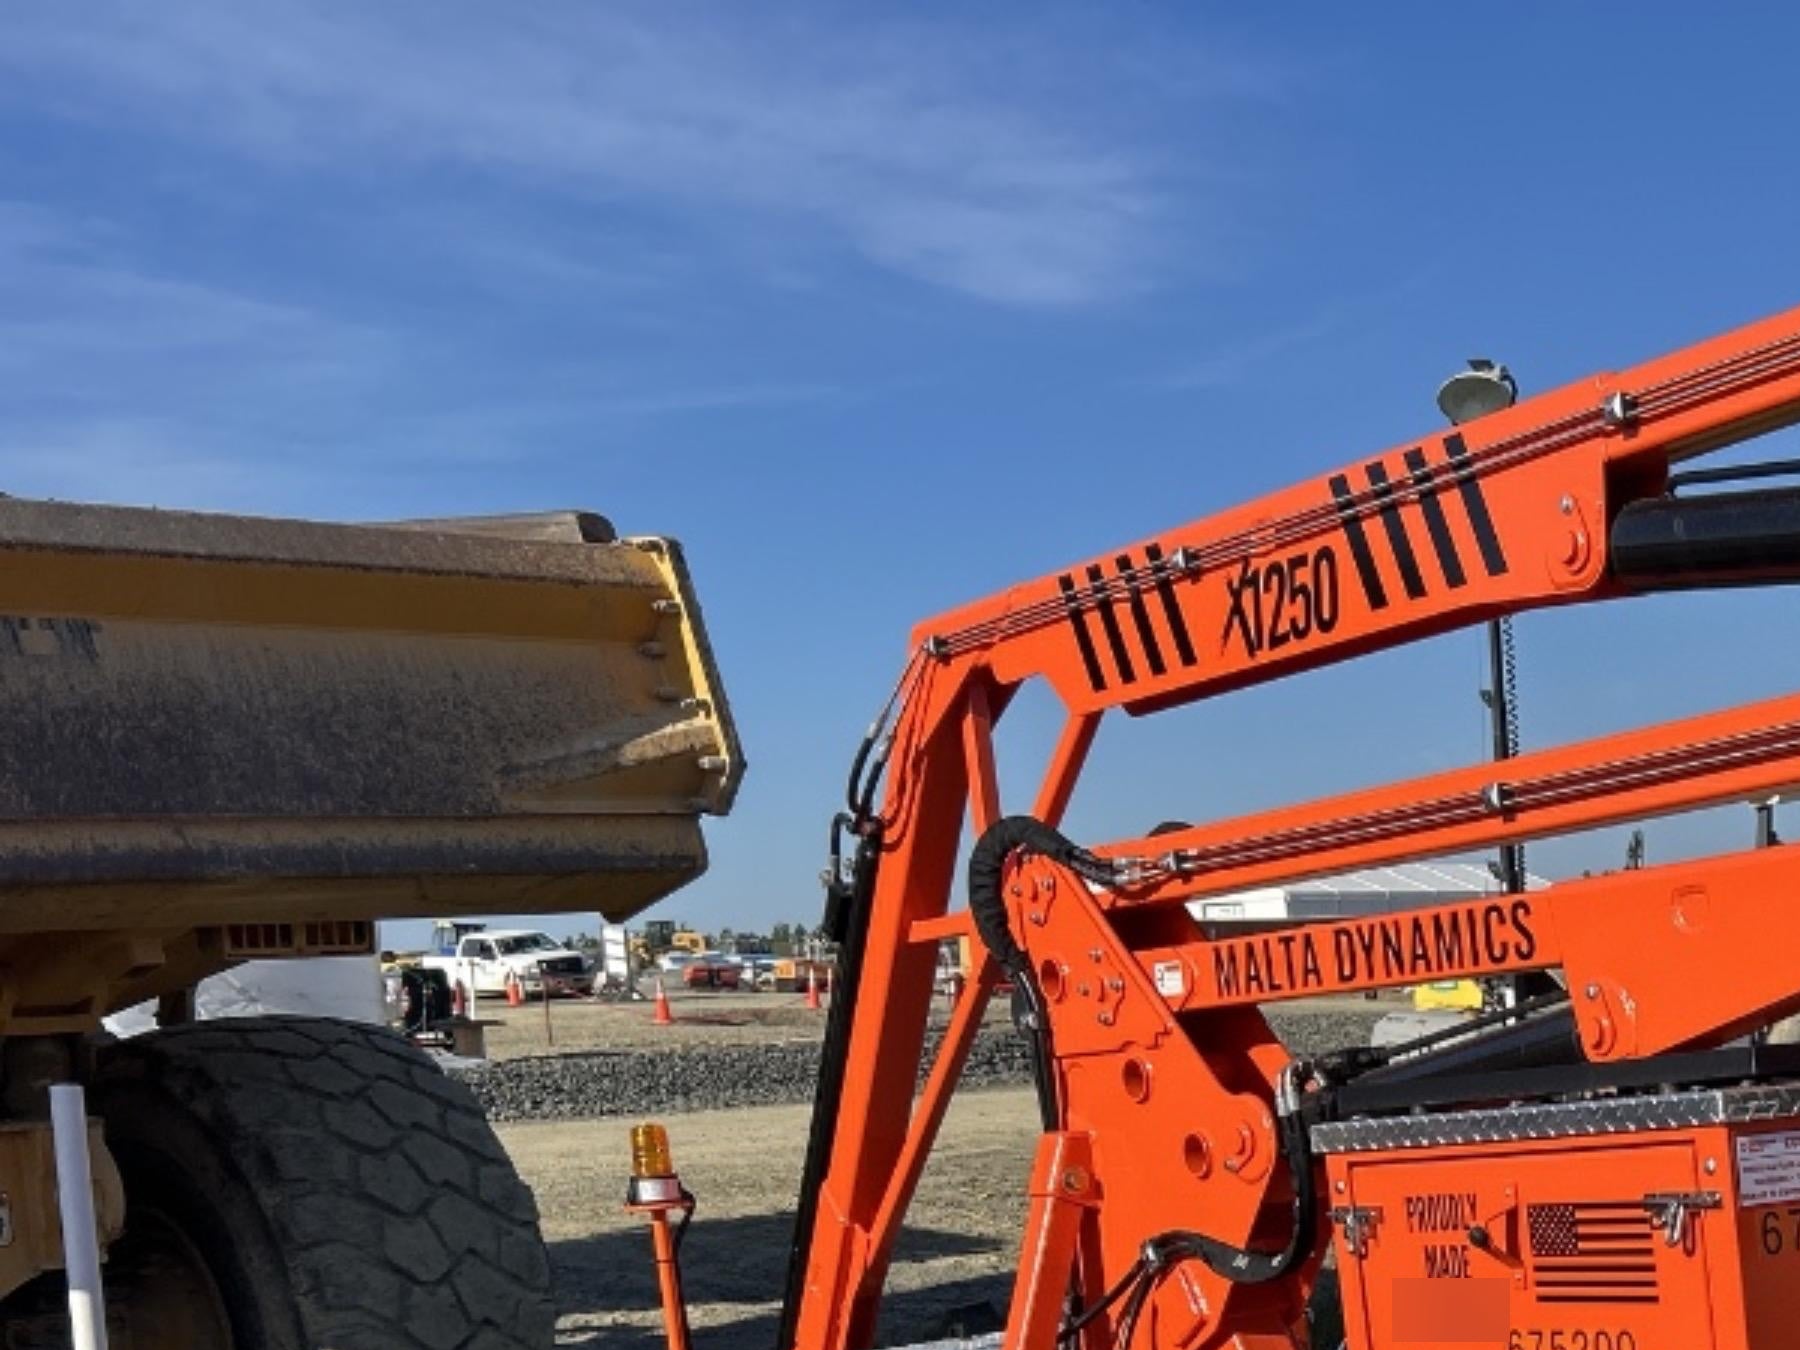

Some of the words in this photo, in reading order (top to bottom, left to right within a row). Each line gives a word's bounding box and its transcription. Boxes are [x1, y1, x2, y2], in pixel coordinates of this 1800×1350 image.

[1220, 545, 1339, 659] X1250
[1212, 933, 1323, 998] MALTA
[1334, 900, 1536, 982] DYNAMICS
[1405, 1193, 1476, 1233] PROUDLY
[1424, 1245, 1472, 1278] MADE
